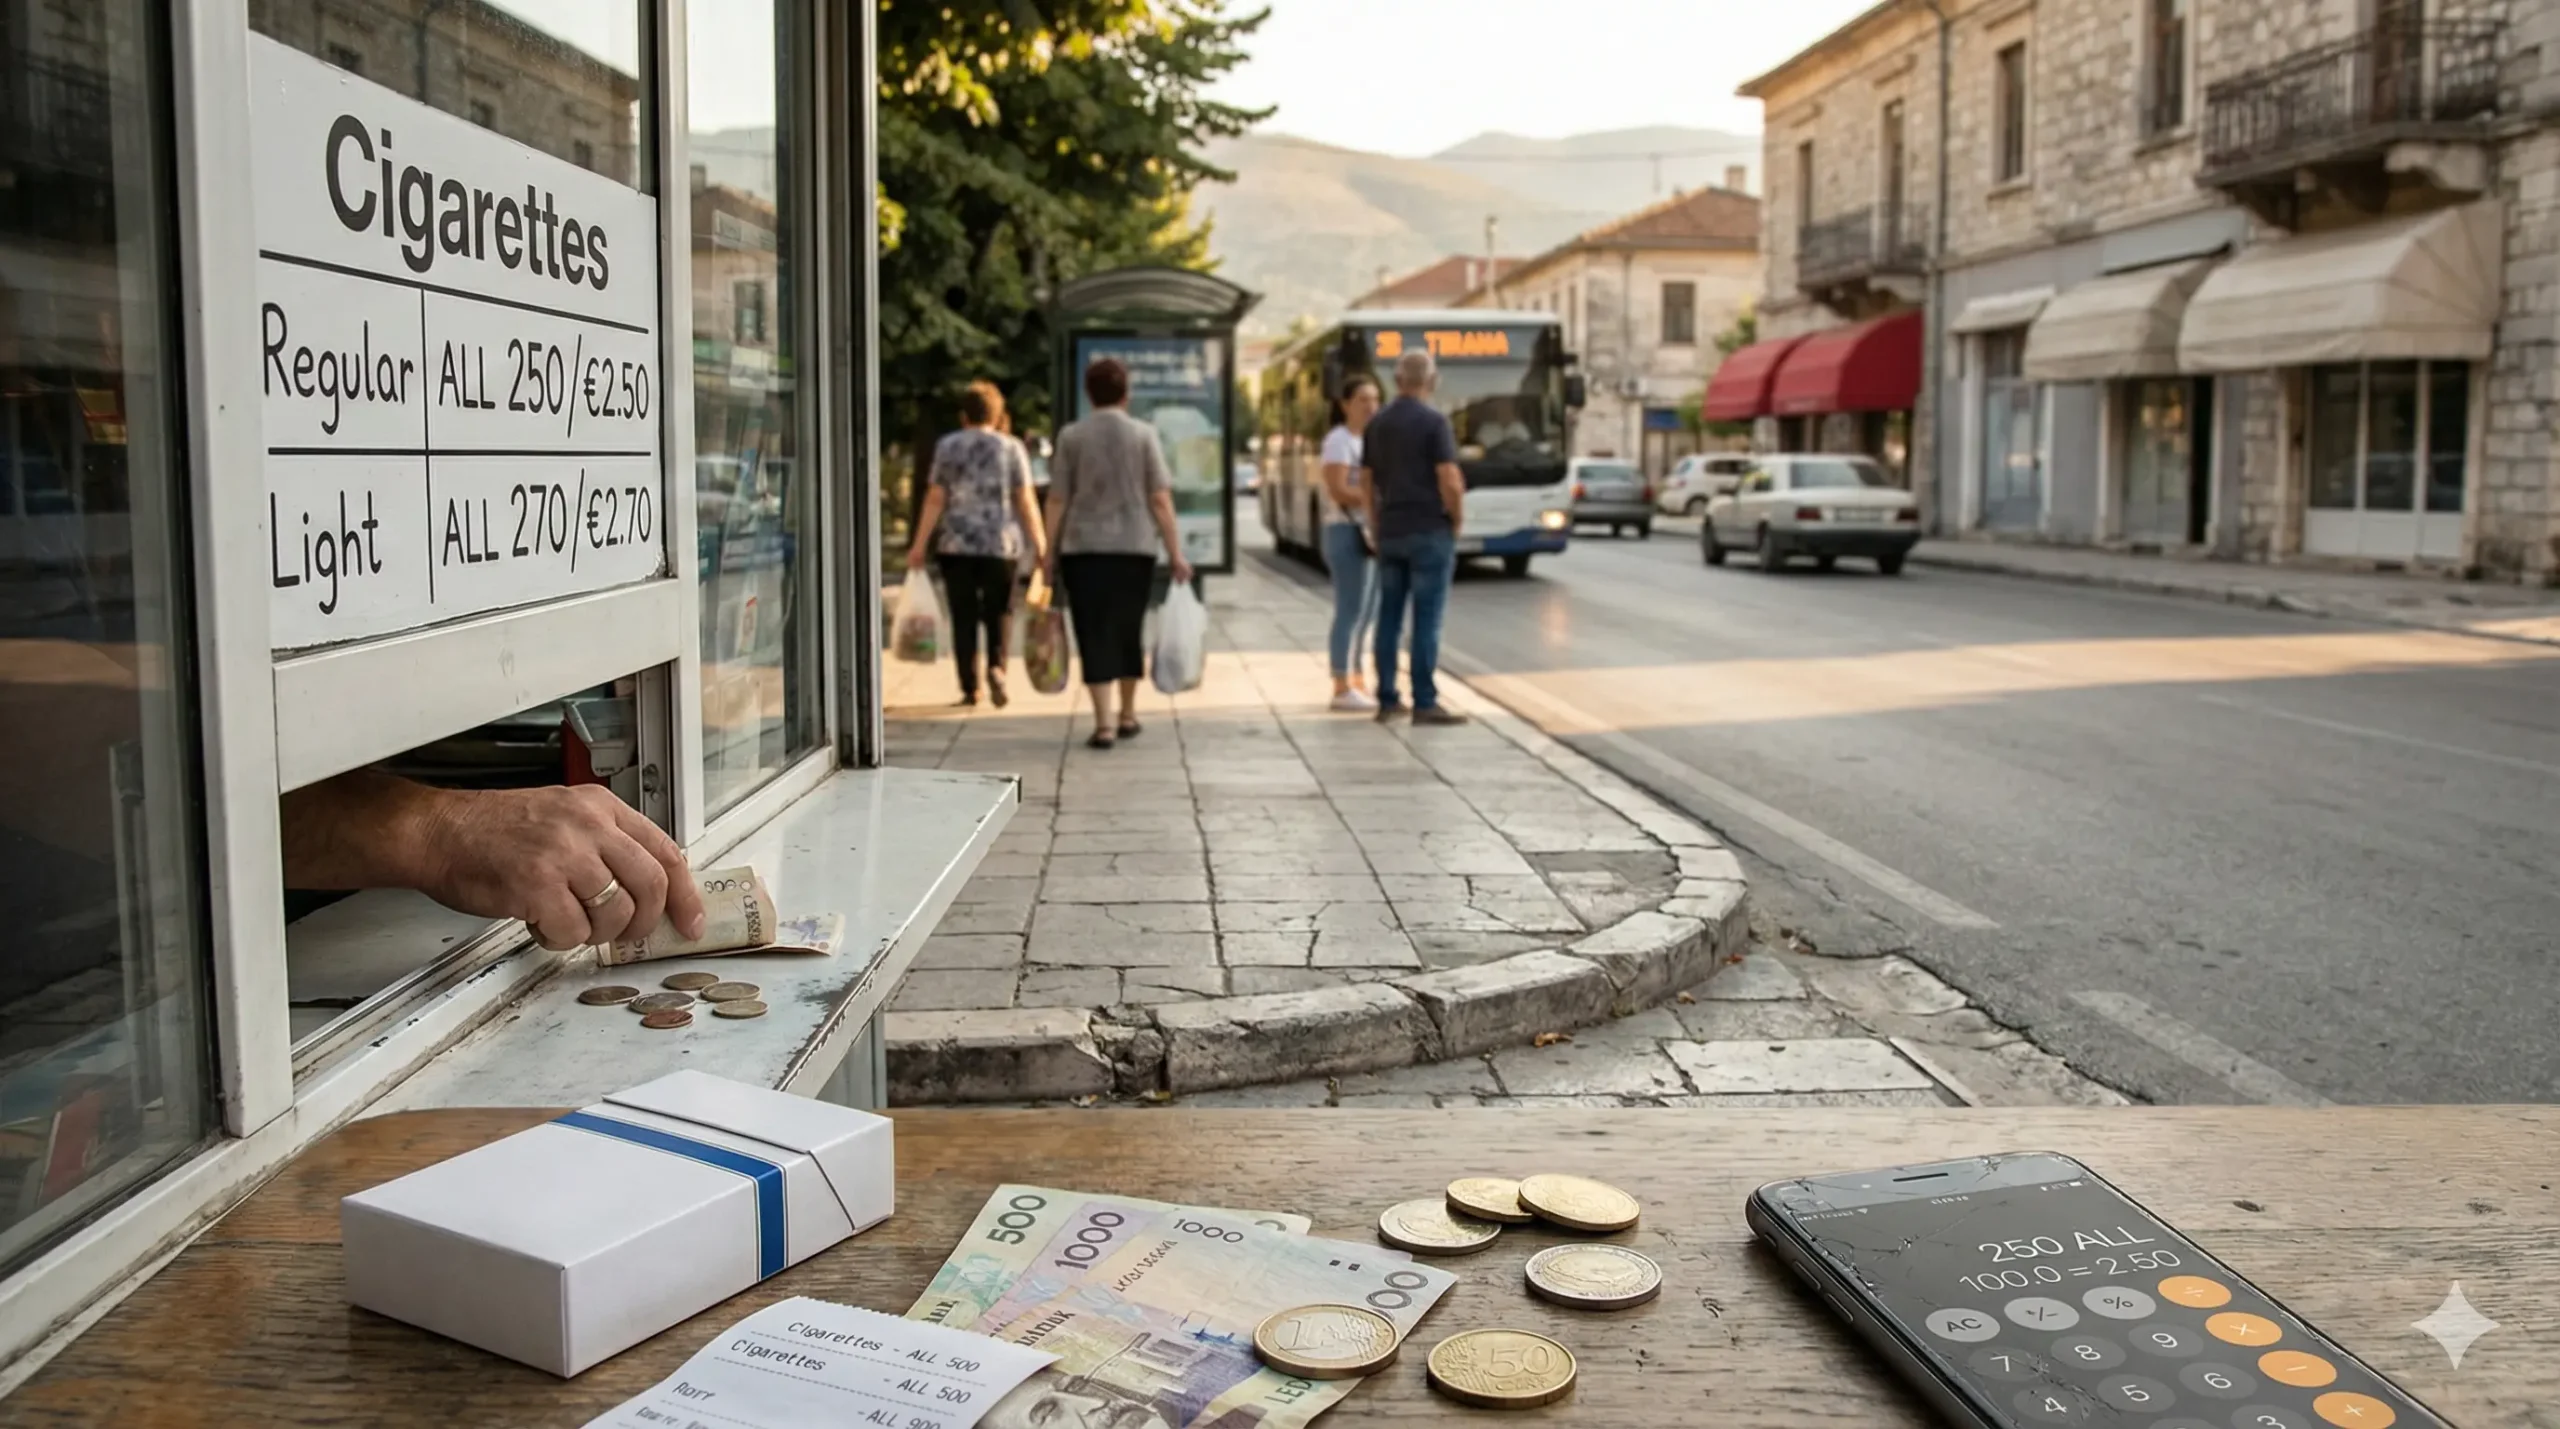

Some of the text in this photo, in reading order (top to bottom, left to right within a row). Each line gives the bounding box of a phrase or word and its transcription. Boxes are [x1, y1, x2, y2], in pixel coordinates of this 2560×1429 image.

[326, 114, 608, 291] Cigarettes
[262, 302, 650, 438] Regular ALL 250/€2.50
[270, 468, 652, 615] Light ALL 270/€2.70
[985, 1194, 1047, 1245] 500
[1173, 1218, 1244, 1243] 1000
[1055, 1211, 1125, 1270] 1000
[1978, 1226, 2155, 1262] 250 ALL
[1959, 1265, 2062, 1292] 100.0
[2096, 1250, 2181, 1276] 2.50
[1945, 1317, 1982, 1333] AC
[906, 1349, 937, 1365] ALL
[945, 1357, 981, 1372] 500
[1488, 1344, 1558, 1378] 50
[1990, 1355, 2010, 1372] 7
[2074, 1345, 2101, 1361] 8
[2151, 1333, 2178, 1348] 9
[897, 1378, 927, 1395] ALL
[936, 1385, 972, 1404] 500
[2044, 1396, 2068, 1414] 4
[2121, 1384, 2150, 1402] 5
[2203, 1372, 2232, 1389] 6
[2256, 1415, 2286, 1429] 3
